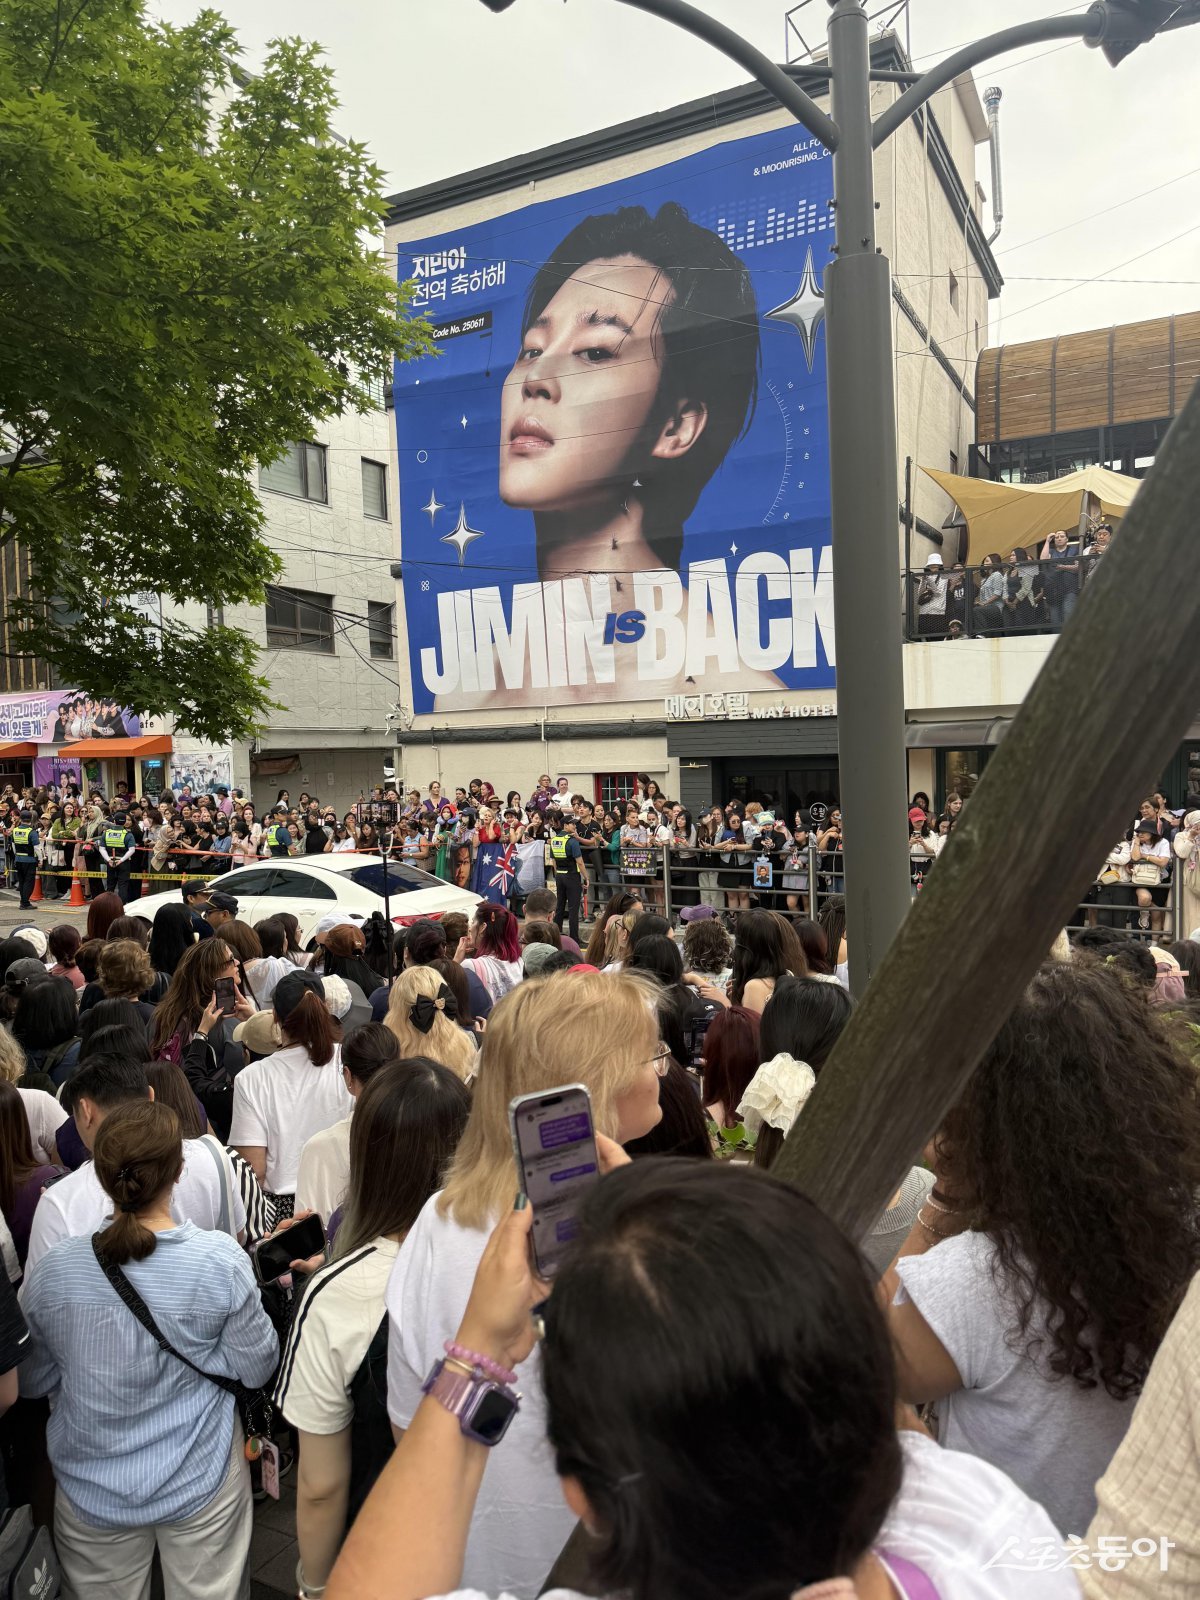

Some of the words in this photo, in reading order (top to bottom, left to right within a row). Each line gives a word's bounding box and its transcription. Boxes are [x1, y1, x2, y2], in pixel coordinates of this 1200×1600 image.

[793, 142, 808, 153] ALL
[810, 138, 821, 148] FO
[753, 168, 760, 176] &
[762, 148, 831, 174] MOONRISING_C
[412, 246, 466, 278] 지민아
[412, 278, 447, 307] 전역
[451, 261, 506, 294] 축하해
[433, 328, 449, 338] Code
[450, 325, 460, 334] No.
[463, 317, 485, 331] 250611
[633, 545, 836, 681] BACK
[421, 575, 616, 695] JIMIN
[602, 610, 647, 645] IS
[140, 720, 154, 729] afe
[753, 706, 785, 718] MAY
[12, 720, 42, 736] 있을게
